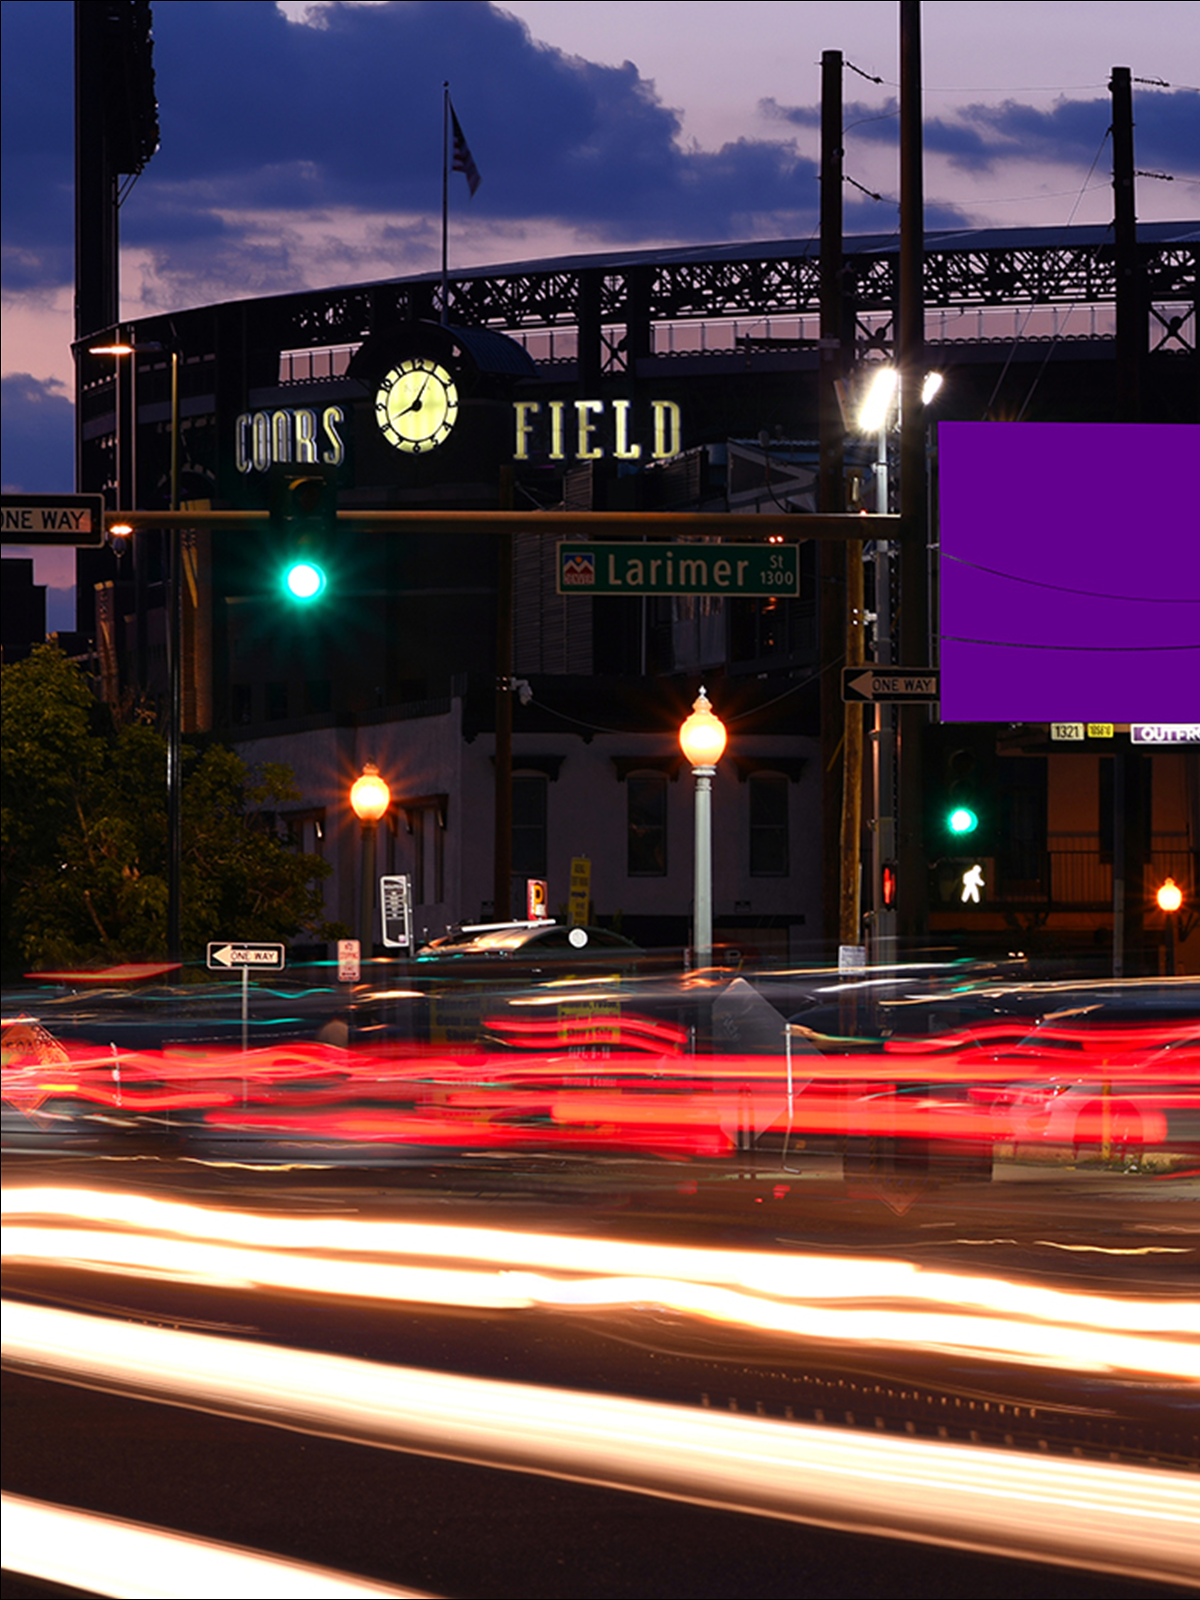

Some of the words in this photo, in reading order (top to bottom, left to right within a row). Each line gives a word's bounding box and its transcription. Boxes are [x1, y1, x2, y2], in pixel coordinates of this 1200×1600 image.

[512, 400, 682, 459] FIELD
[41, 511, 84, 529] WAY
[608, 551, 749, 586] Larimer
[770, 554, 784, 569] St
[760, 571, 794, 585] 1300
[872, 679, 898, 691] ONE
[904, 680, 931, 691] WAY
[1056, 725, 1079, 738] 1321
[230, 951, 249, 960] ONE
[254, 952, 274, 960] WAY
